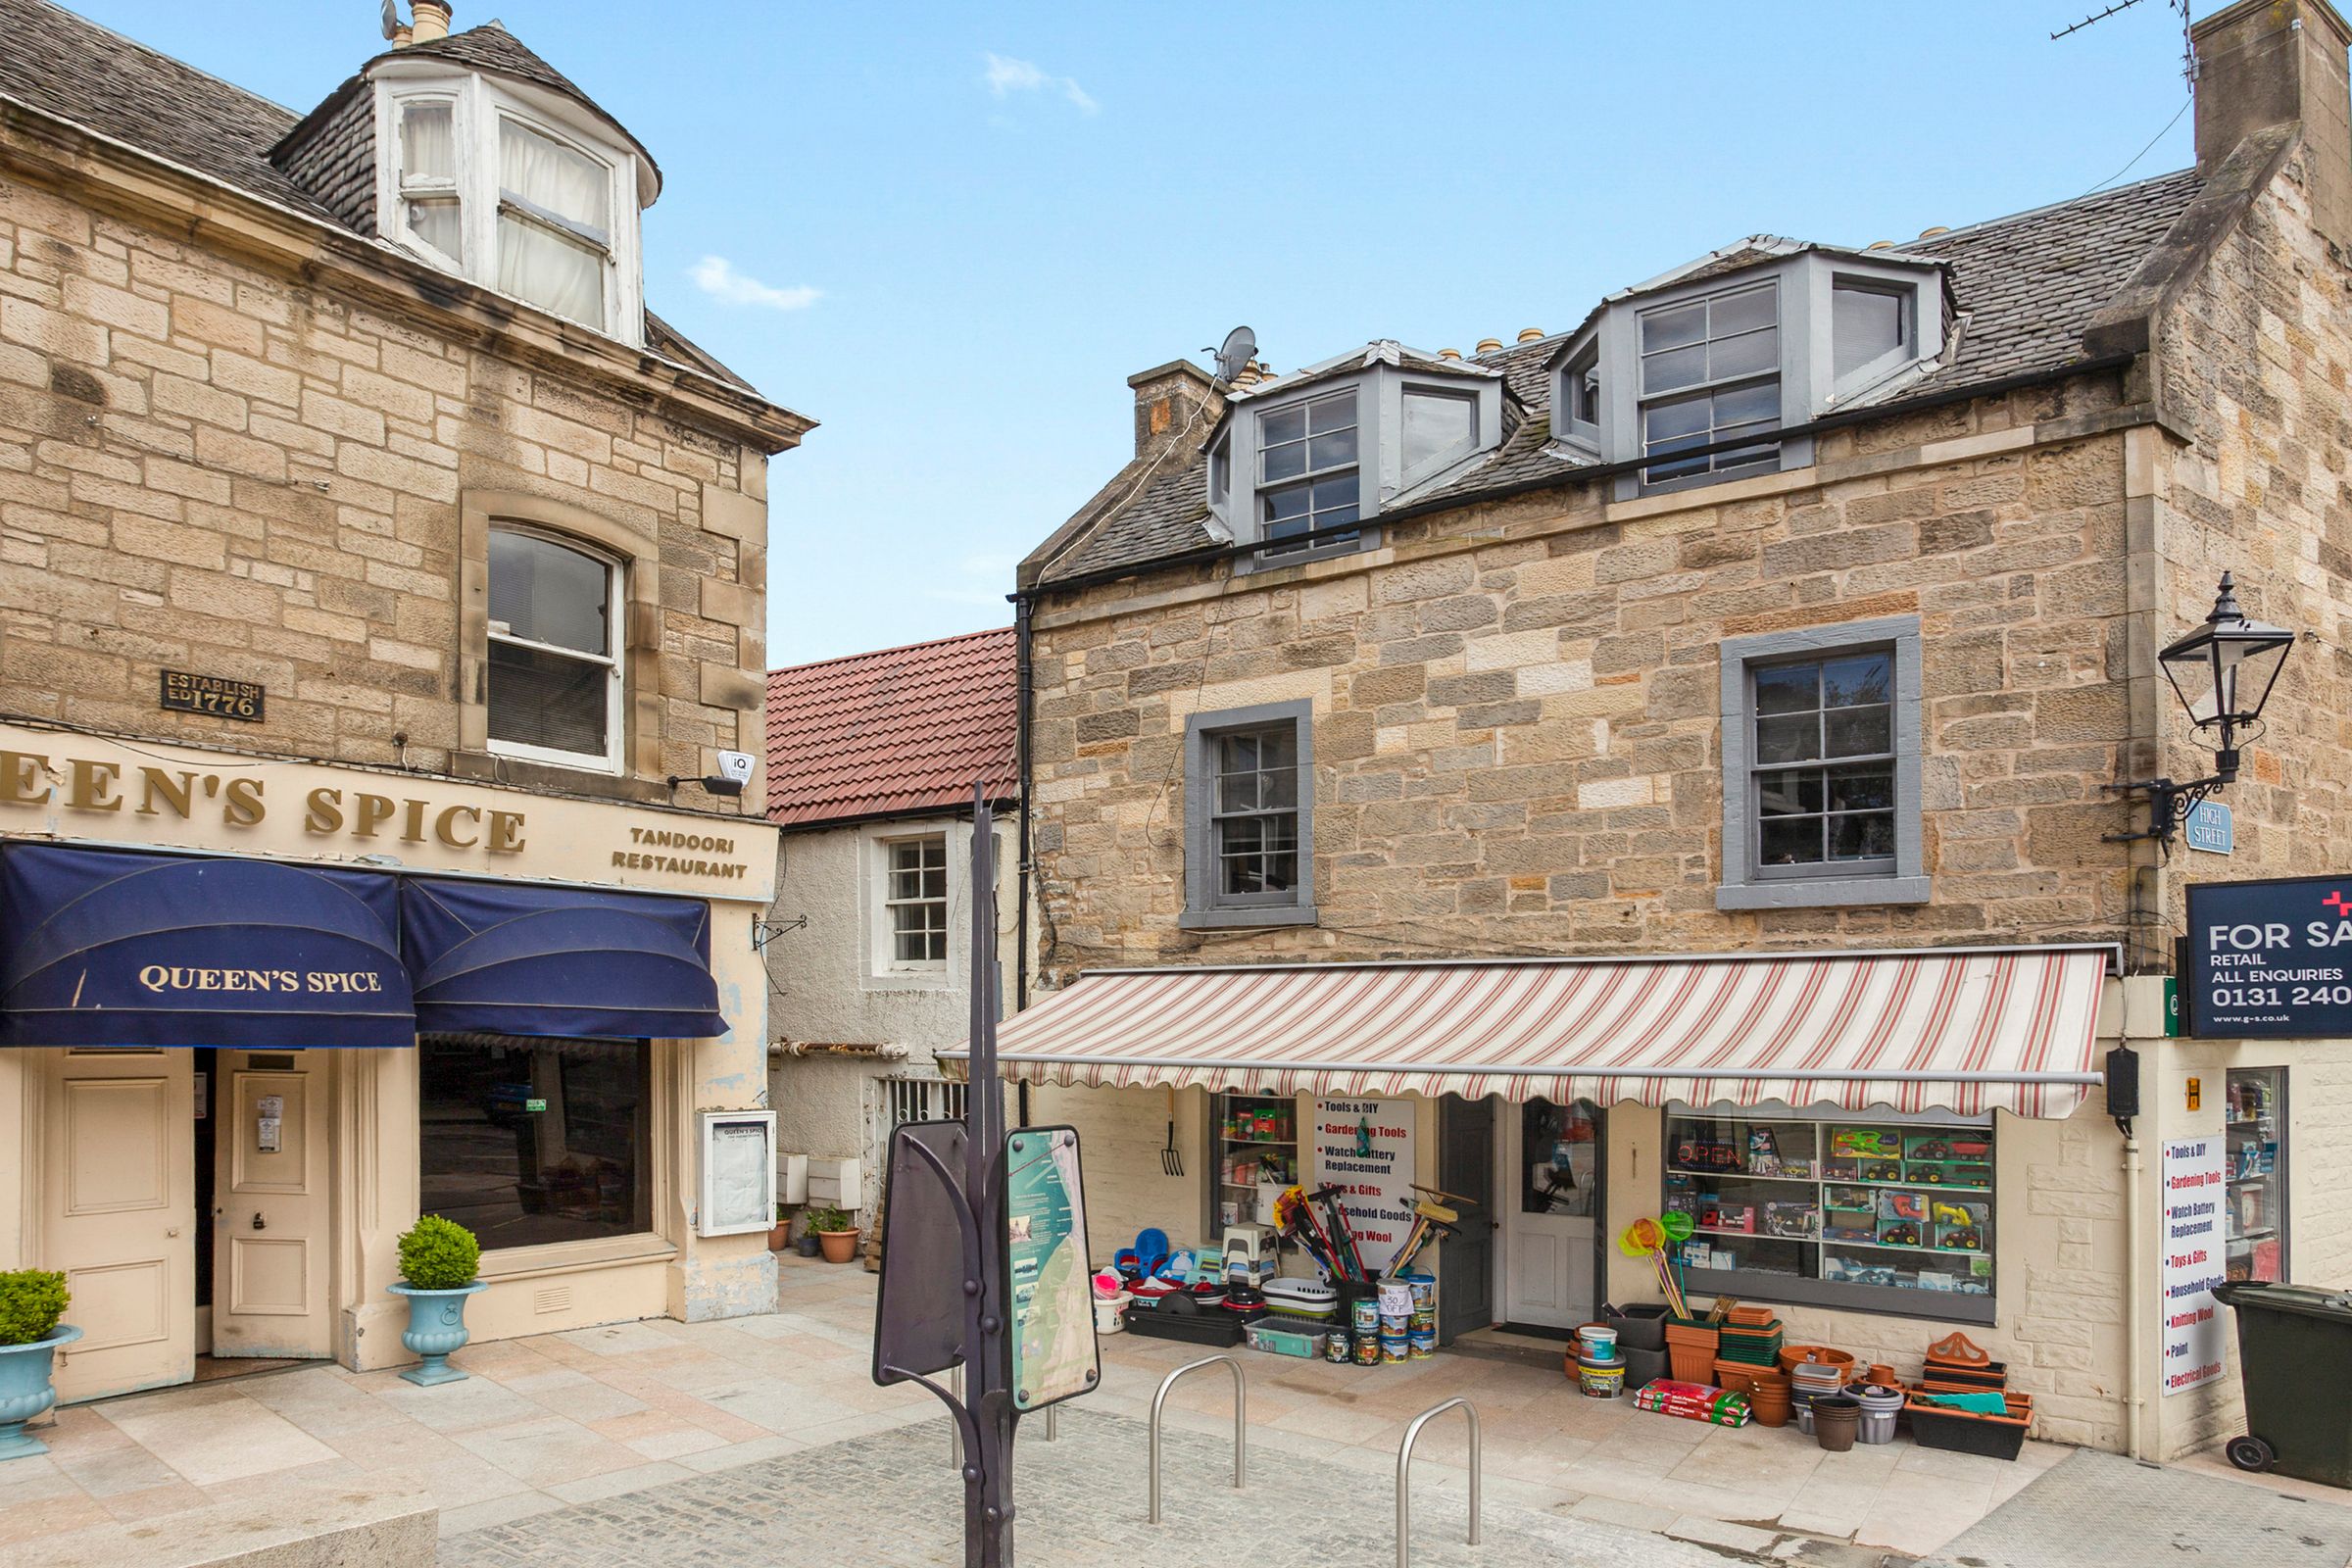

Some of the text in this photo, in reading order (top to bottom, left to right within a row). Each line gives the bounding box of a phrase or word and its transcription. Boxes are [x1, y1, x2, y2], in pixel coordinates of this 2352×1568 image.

[168, 673, 260, 699] ESTABLISH
[169, 687, 255, 716] ED 1776
[733, 758, 747, 769] iQ
[305, 787, 526, 853] SPICE
[2199, 806, 2221, 825] HIGH
[630, 827, 735, 855] TANDOORI
[2194, 825, 2226, 847] STREET
[612, 851, 748, 879] RESTAURANT
[2209, 923, 2291, 951] FOR
[2210, 954, 2267, 966] RETAIL
[139, 964, 382, 993] QUEEN'S SPICE
[2212, 968, 2344, 983] ALL ENQUIRIES
[2212, 985, 2352, 1007] 0131 240
[2213, 1014, 2290, 1024] www.g-s.co.uk
[1325, 1102, 1351, 1112] Tools
[1378, 1126, 1407, 1138] Tools
[1325, 1146, 1356, 1157] Watch
[1677, 1145, 1741, 1166] OPEN
[2172, 1143, 2206, 1159] Tools & DIY
[1325, 1160, 1391, 1174] Replacement
[2171, 1170, 2221, 1190] Gardening Tools
[1349, 1185, 1357, 1194] &
[1358, 1185, 1382, 1197] Gifts
[1380, 1208, 1411, 1222] Goods
[2171, 1201, 2215, 1219] Watch Battery
[1365, 1230, 1392, 1243] Wool
[2171, 1219, 2213, 1238] Replacement
[2171, 1250, 2207, 1268] Toys & Gifts
[2171, 1278, 2205, 1298] Household
[2171, 1305, 2214, 1328] Knitting Wool
[2171, 1342, 2188, 1358] Paint
[2171, 1361, 2221, 1388] Electrical Goods
